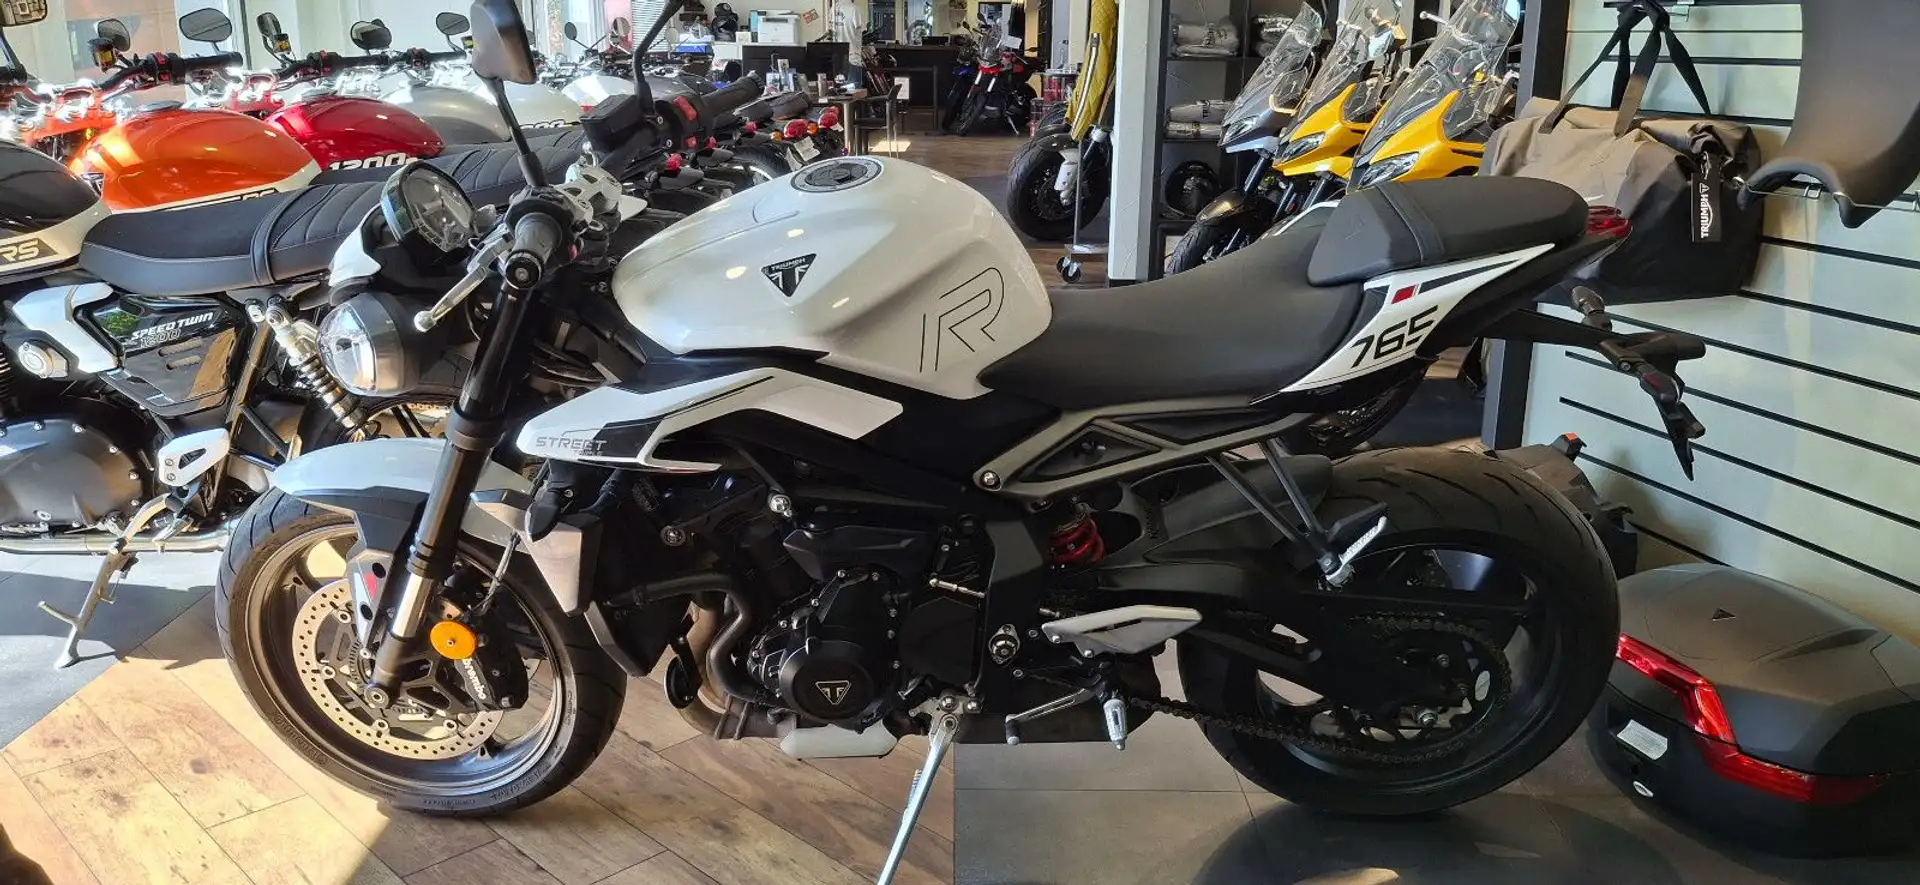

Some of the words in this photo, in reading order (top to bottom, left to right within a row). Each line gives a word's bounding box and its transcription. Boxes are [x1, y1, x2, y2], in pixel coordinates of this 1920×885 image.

[1700, 193, 1713, 239] TRIUMPH
[0, 239, 40, 262] RS
[131, 321, 177, 341] SPEED
[178, 312, 214, 328] TWIN
[919, 266, 1005, 373] R
[1350, 304, 1438, 369] 765
[535, 436, 608, 451] STREET
[462, 657, 487, 700] brembo
